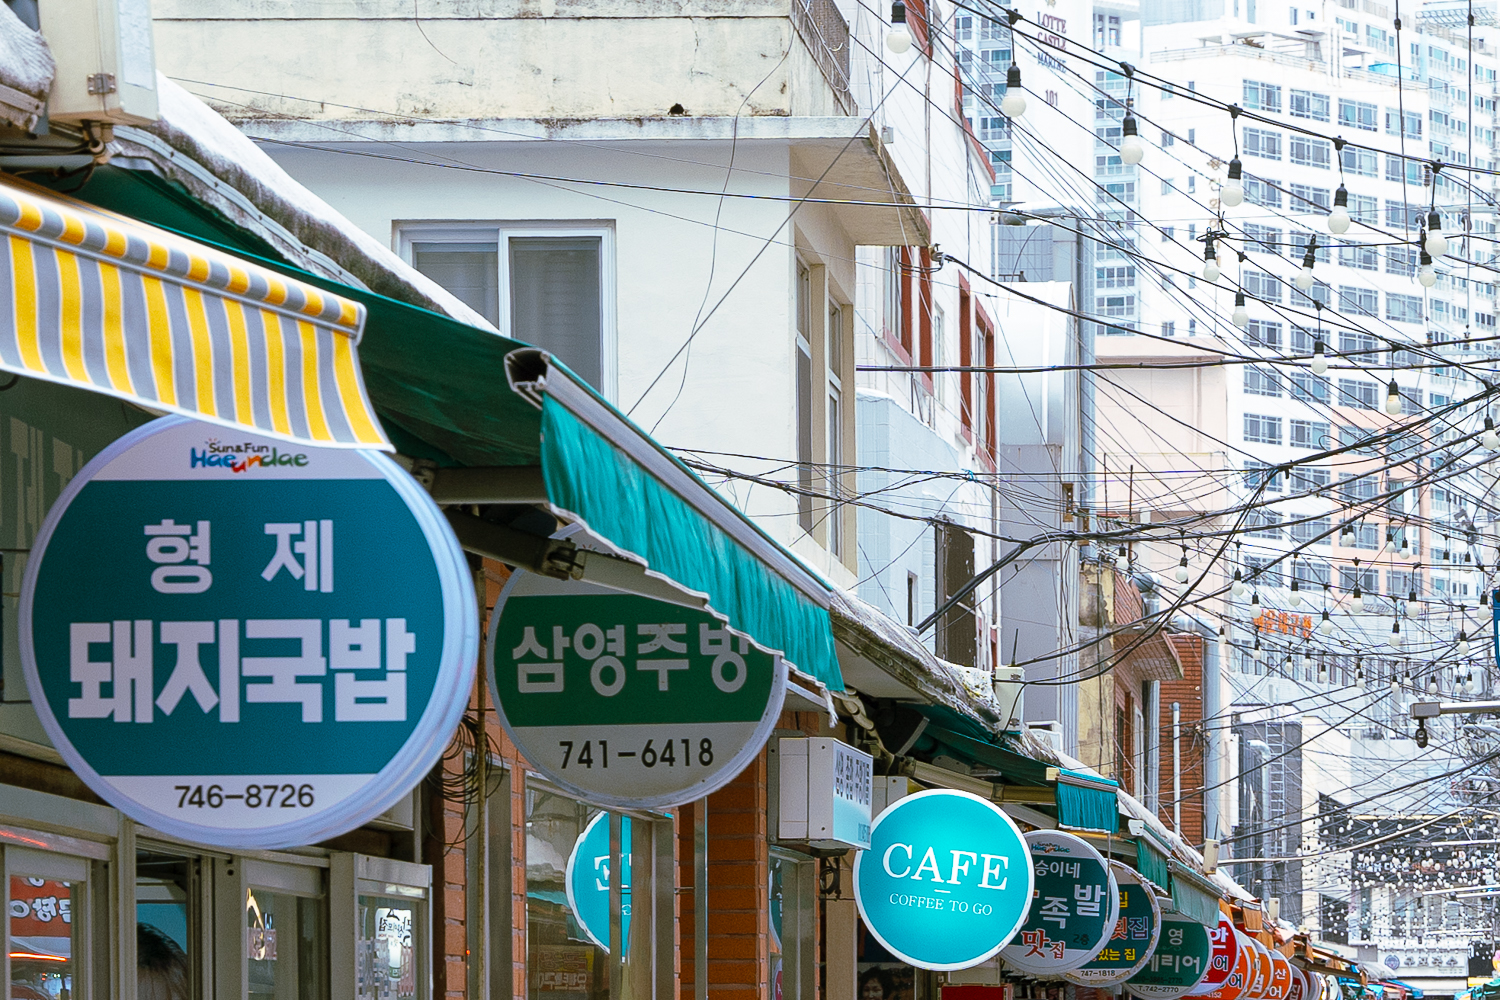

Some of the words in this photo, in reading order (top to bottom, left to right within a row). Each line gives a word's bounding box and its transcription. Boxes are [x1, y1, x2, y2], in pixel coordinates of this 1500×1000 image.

[190, 447, 309, 473] Haeundae
[68, 618, 416, 724] 돼지국밥
[512, 623, 749, 697] 삼영주방
[559, 737, 714, 769] 741-6418
[174, 784, 314, 808] 746-8726
[883, 843, 1009, 890] CAFE
[889, 893, 944, 911] COFFEE
[950, 899, 968, 913] TO
[972, 901, 993, 917] GO
[1039, 884, 1106, 930] 족발
[1022, 929, 1065, 960] 맛집
